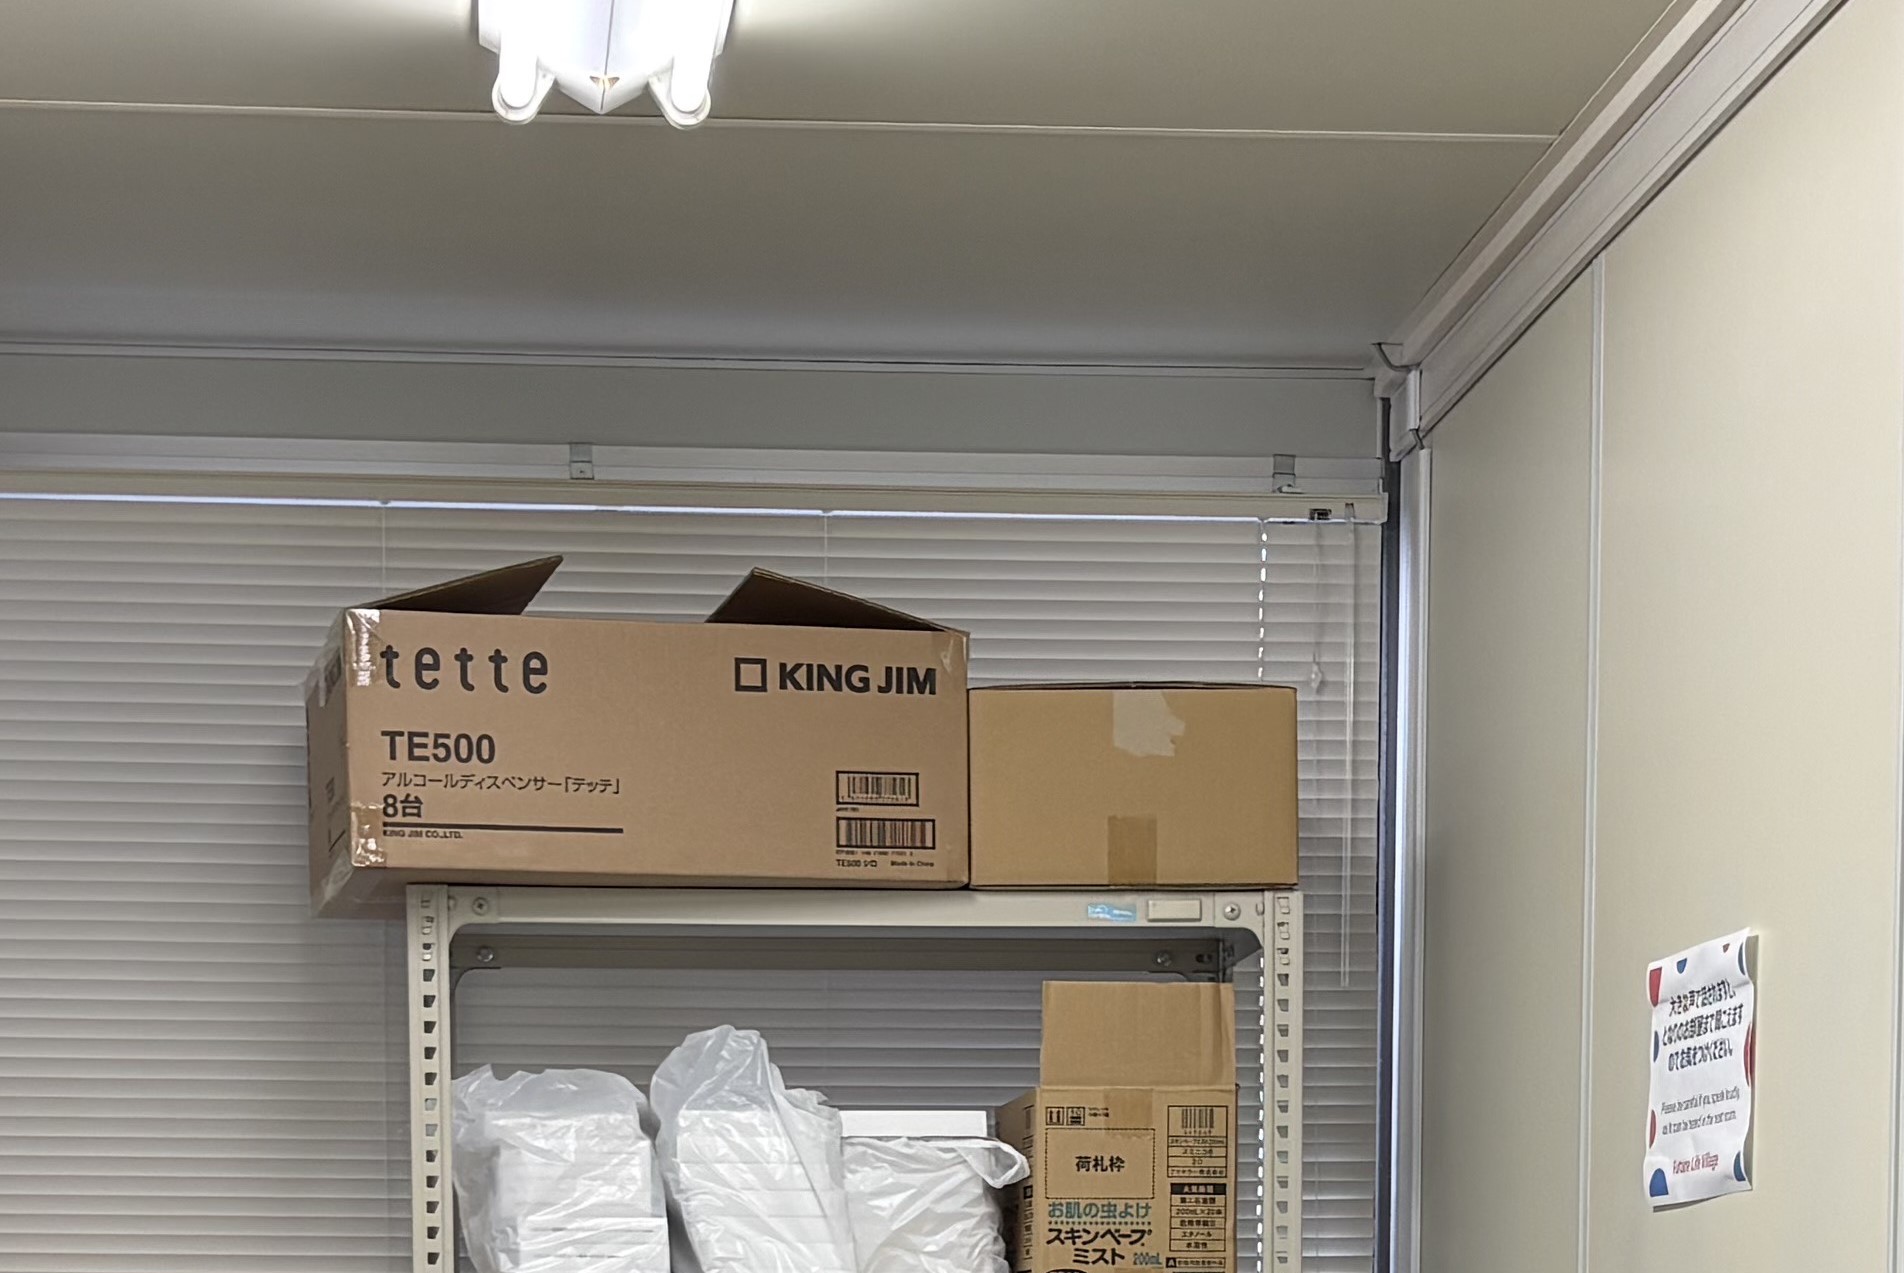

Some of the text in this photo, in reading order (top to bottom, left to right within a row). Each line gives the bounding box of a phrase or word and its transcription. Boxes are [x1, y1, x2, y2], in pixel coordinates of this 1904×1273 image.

[379, 645, 549, 694] tette
[779, 662, 937, 695] KING JIM
[380, 730, 496, 764] TE500
[381, 771, 620, 794] アルコールディスペンサー「テッテ」
[382, 793, 424, 819] 8台
[1075, 1155, 1126, 1172] 荷札枠
[1047, 1201, 1152, 1220] お肌の虫よけ
[1072, 1247, 1126, 1266] ミスト
